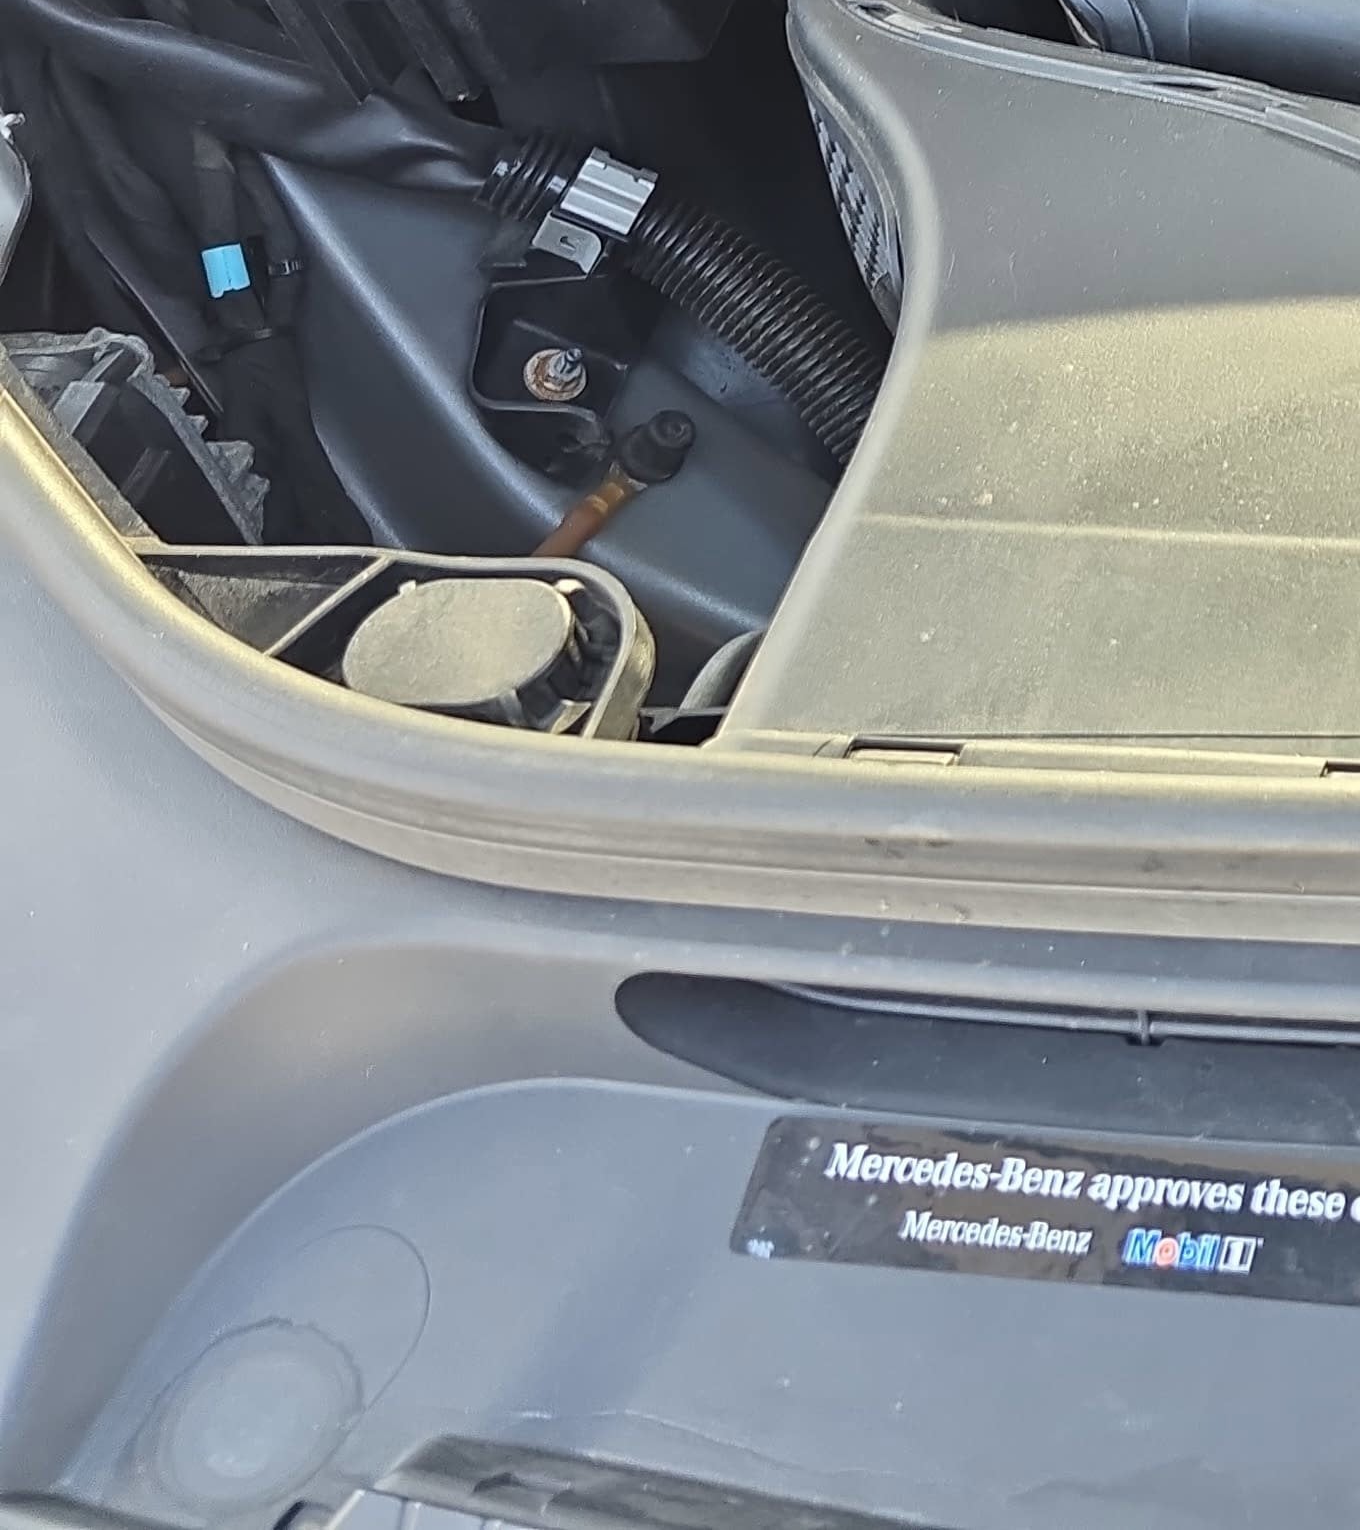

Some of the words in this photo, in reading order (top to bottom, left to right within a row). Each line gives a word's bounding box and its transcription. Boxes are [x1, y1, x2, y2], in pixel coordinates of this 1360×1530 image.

[823, 1141, 1086, 1200] Mercedes-Benz
[1086, 1171, 1245, 1213] approves
[1249, 1178, 1347, 1223] these
[898, 1210, 1093, 1256] Mercedes-Benz
[1123, 1226, 1217, 1270] Mobil
